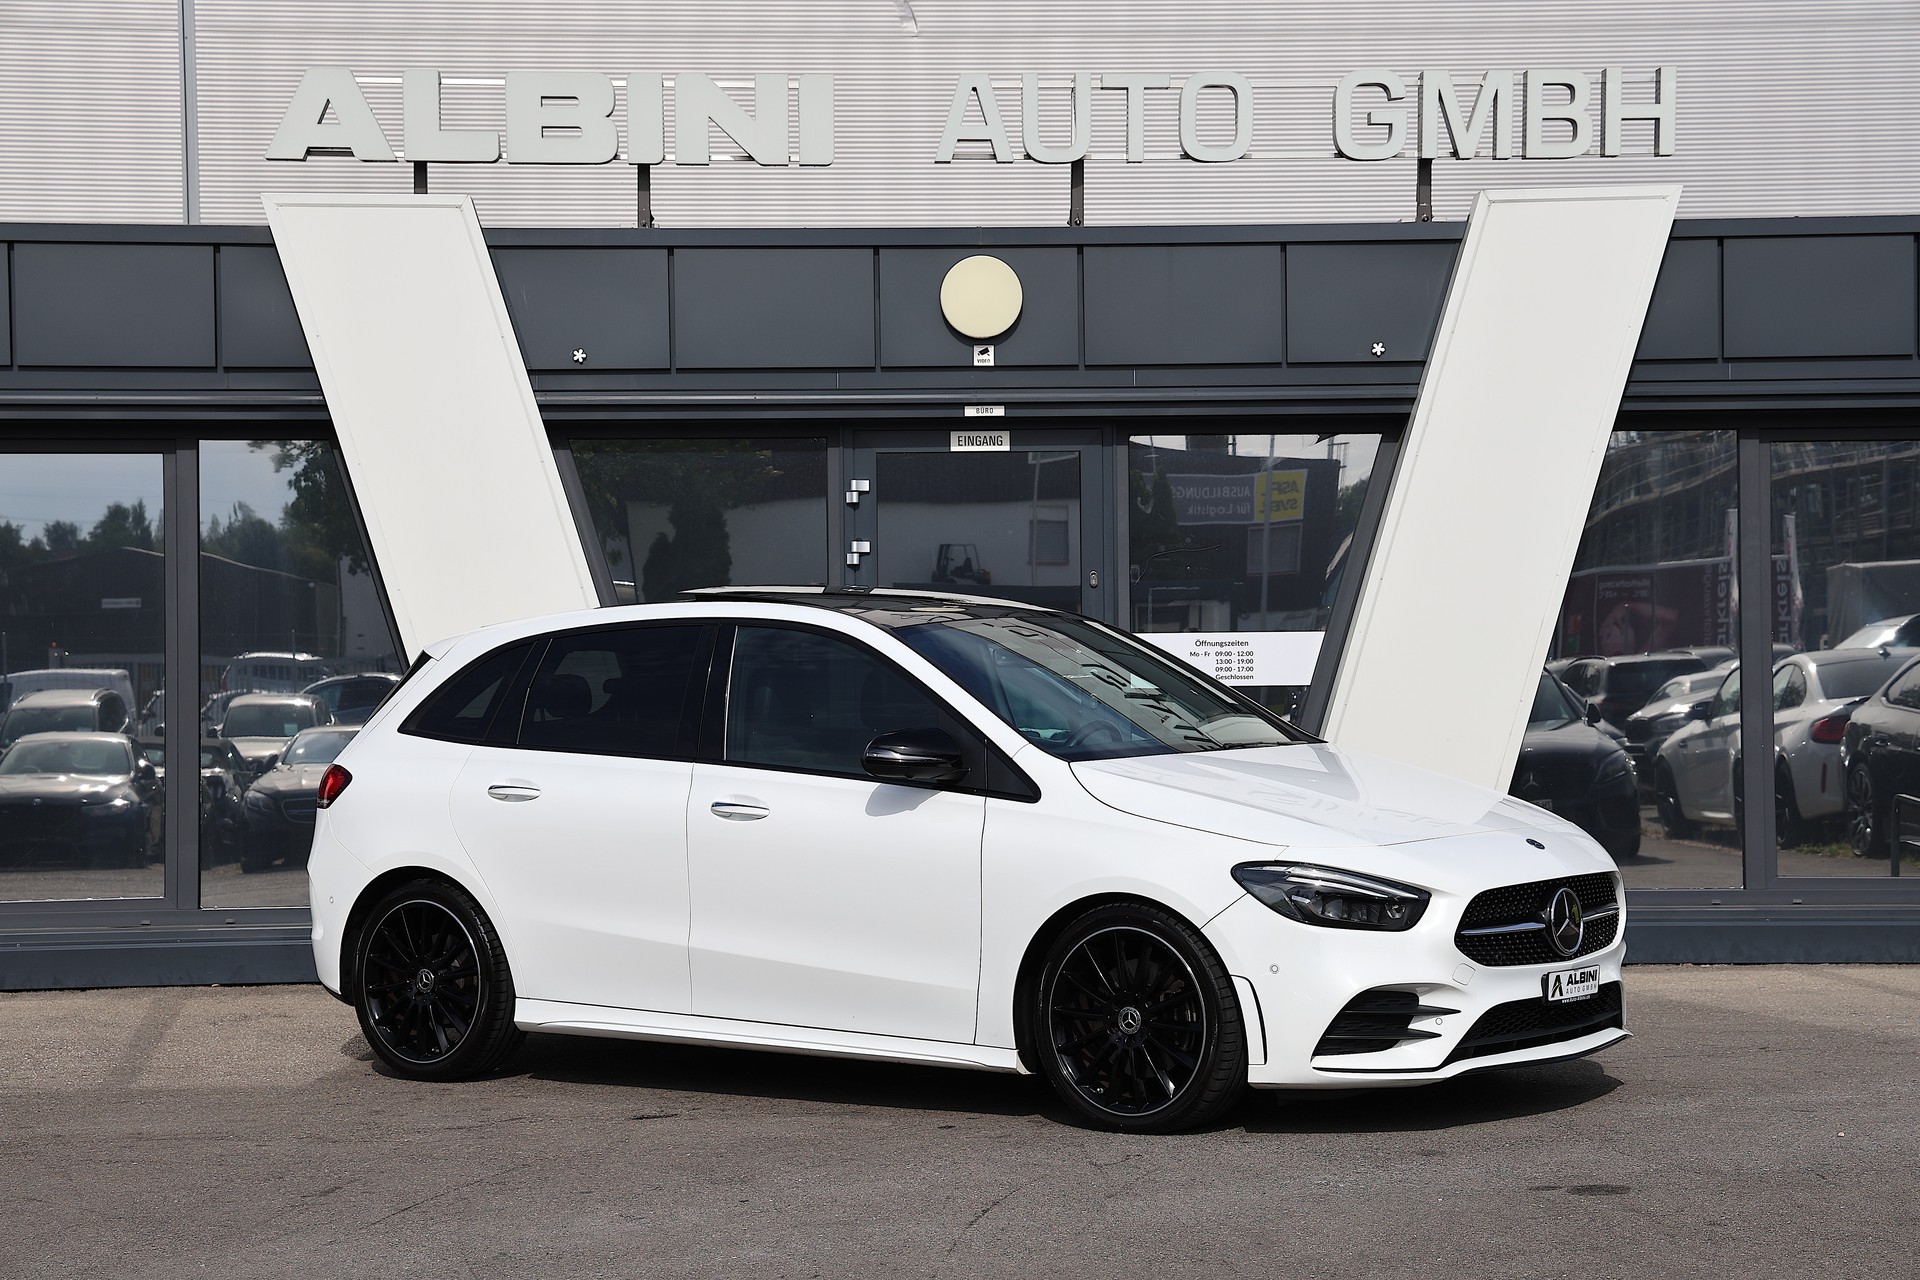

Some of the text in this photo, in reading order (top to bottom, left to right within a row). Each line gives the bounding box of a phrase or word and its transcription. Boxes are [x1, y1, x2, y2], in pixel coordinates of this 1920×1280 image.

[264, 65, 1678, 168] ALBINI AUTO GMBH
[957, 435, 1003, 447] EINGANG
[1195, 639, 1248, 648] Öffnungszeiten
[1215, 673, 1254, 681] Geschlossen
[1566, 969, 1598, 986] ALBINI
[1566, 983, 1597, 994] AUTO GMBH
